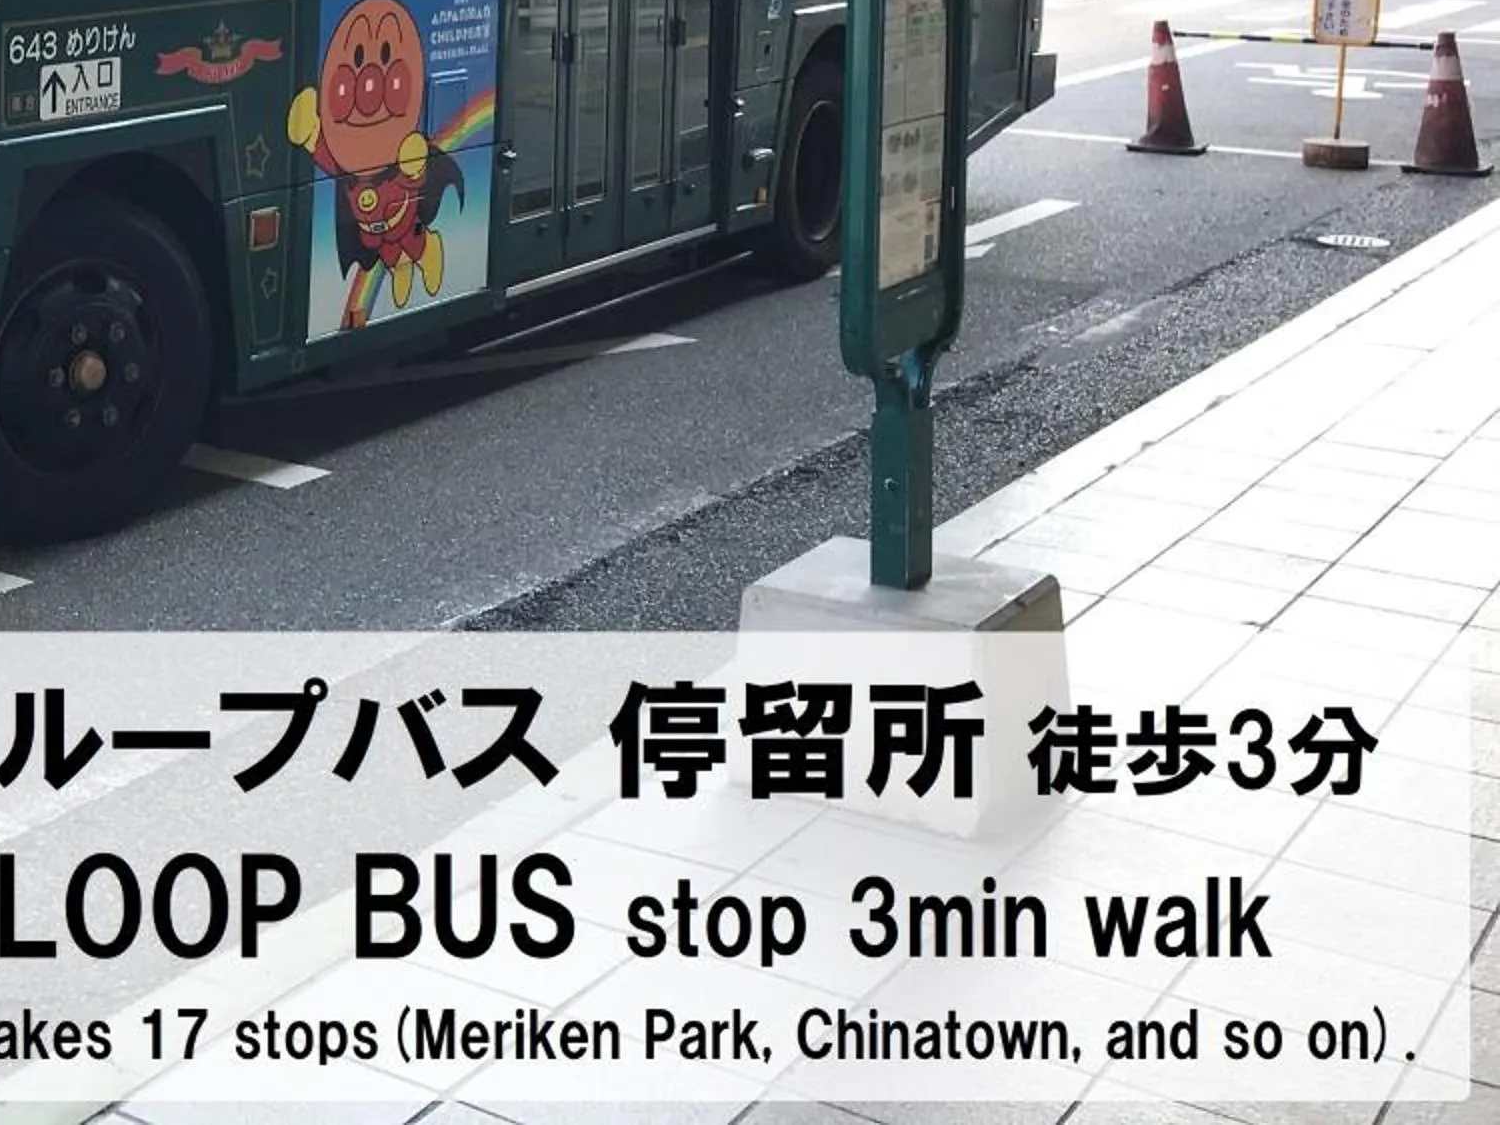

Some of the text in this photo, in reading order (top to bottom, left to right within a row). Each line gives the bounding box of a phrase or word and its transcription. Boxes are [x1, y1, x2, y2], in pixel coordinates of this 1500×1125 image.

[9, 23, 137, 65] 643 めりけん
[71, 60, 114, 94] 入口
[65, 91, 120, 116] ENTRANCE
